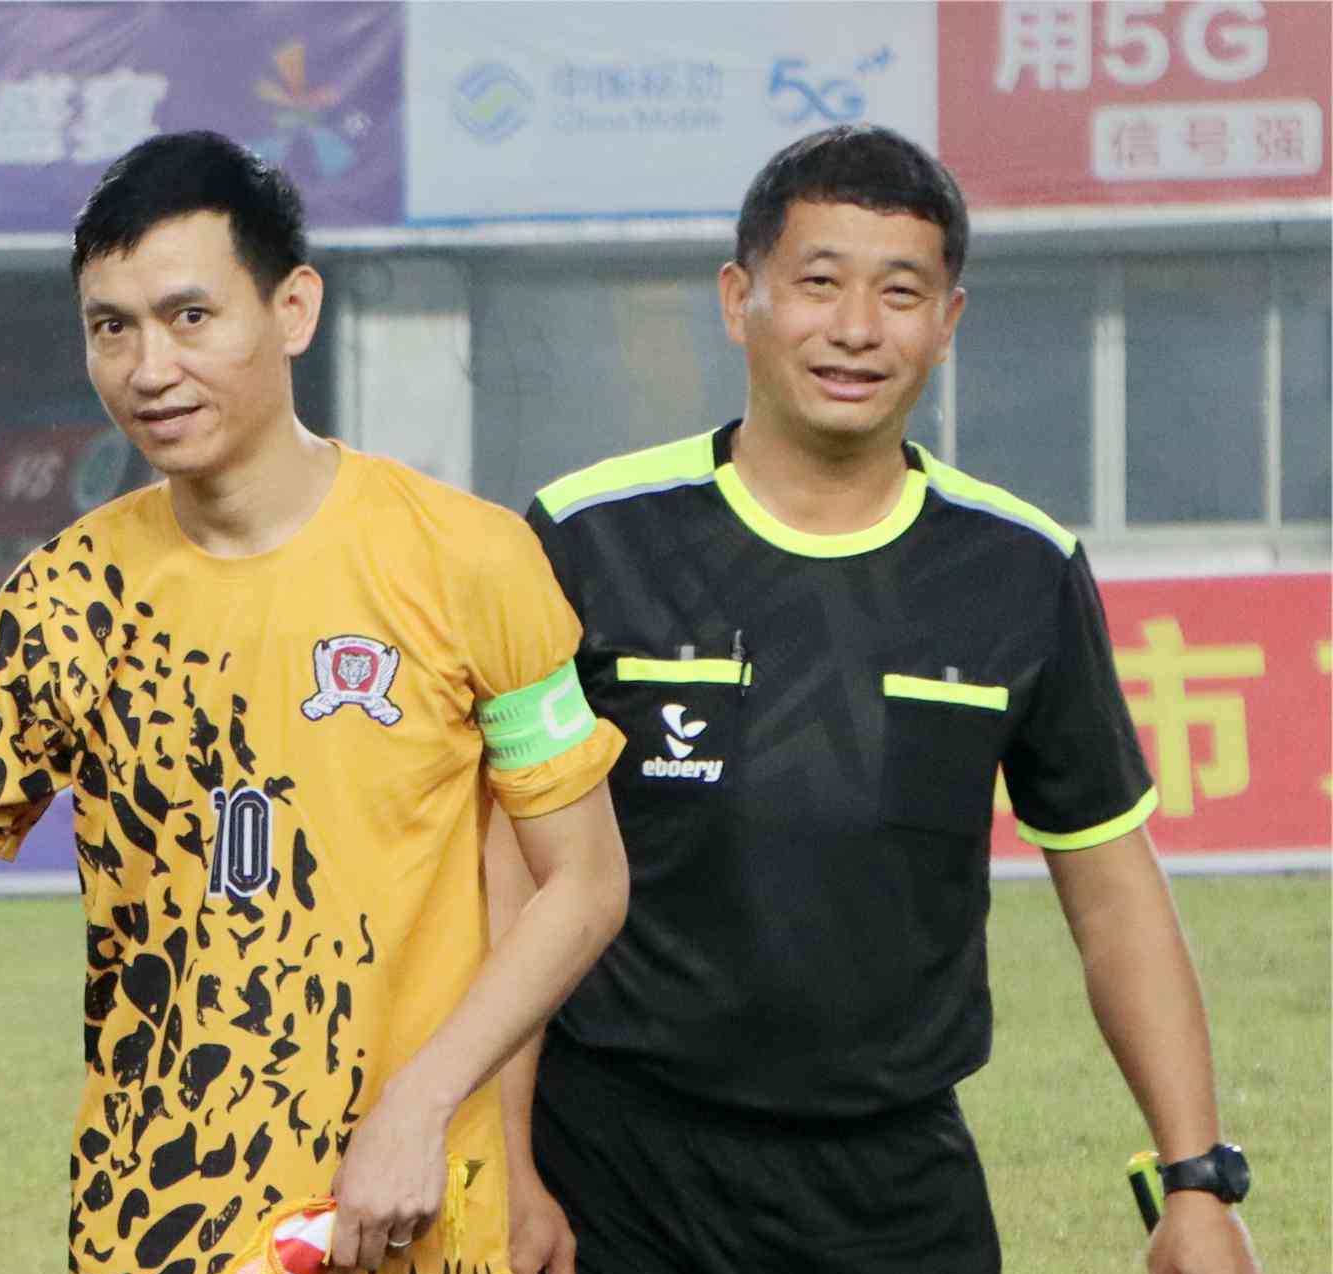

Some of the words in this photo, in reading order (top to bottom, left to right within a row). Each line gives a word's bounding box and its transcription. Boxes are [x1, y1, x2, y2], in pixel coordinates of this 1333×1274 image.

[993, 0, 1269, 92] 用5G
[1110, 115, 1303, 169] 信号强
[641, 755, 724, 783] eboery
[207, 787, 272, 897] 10
